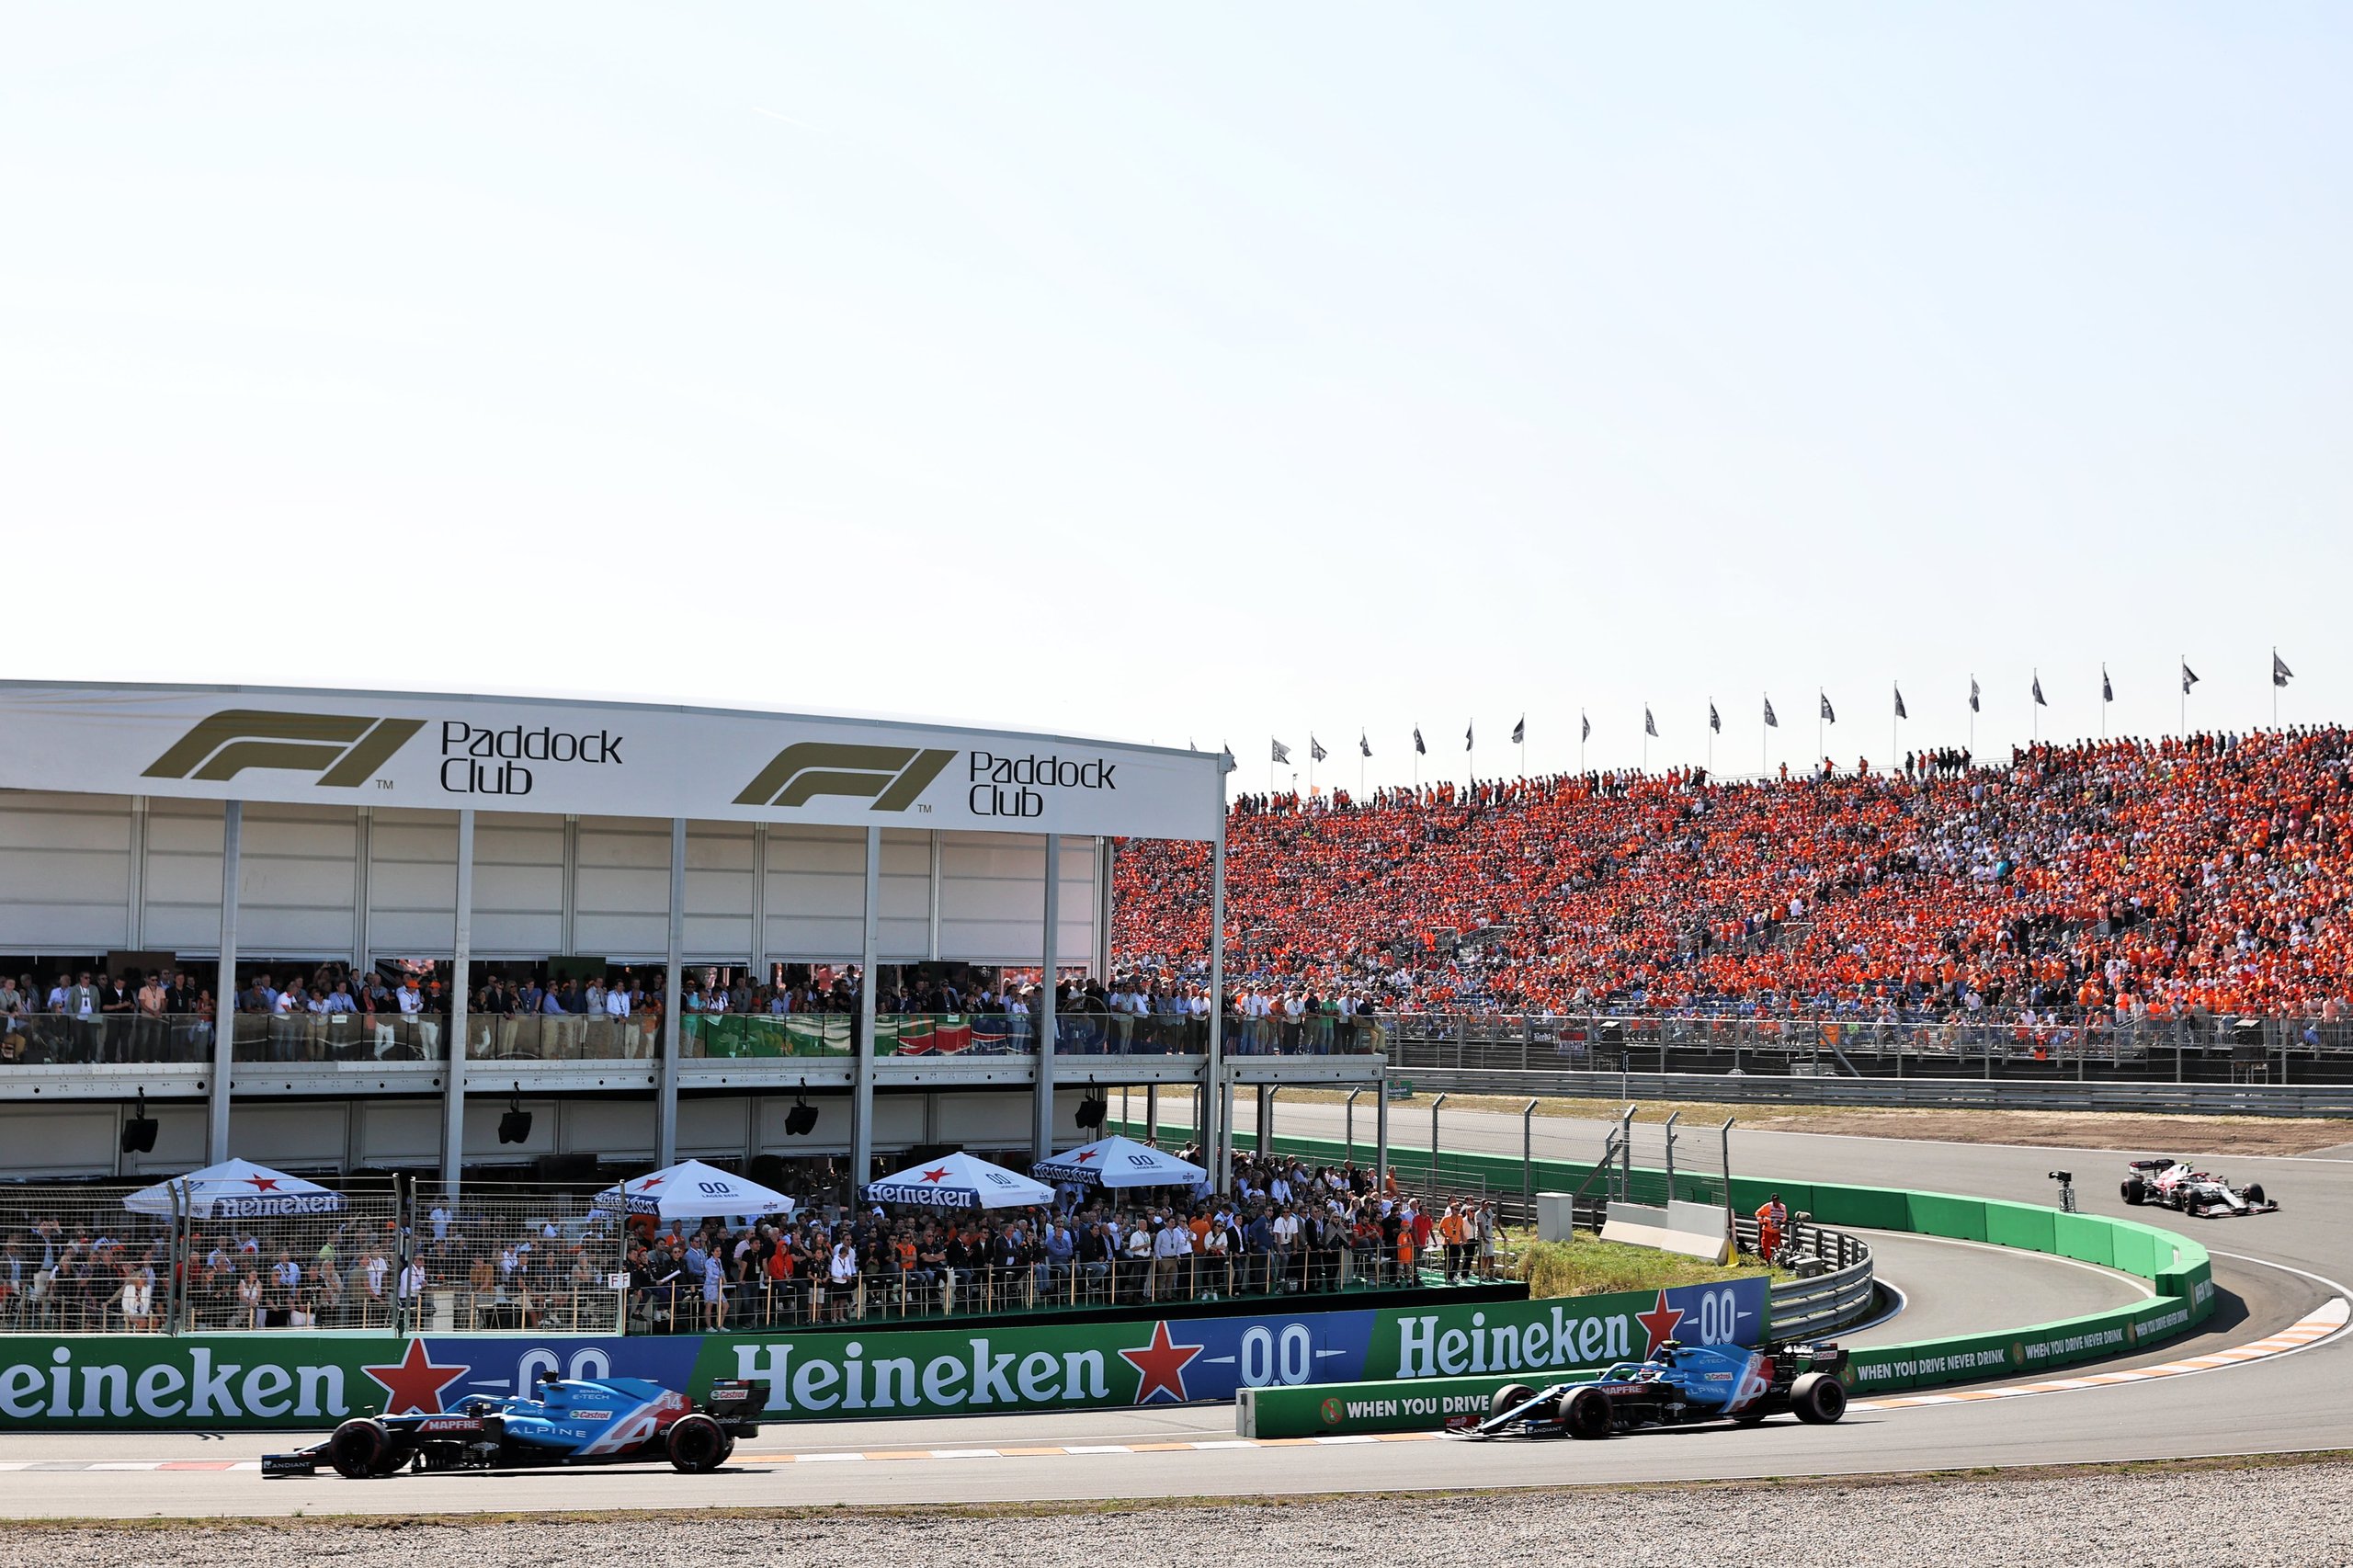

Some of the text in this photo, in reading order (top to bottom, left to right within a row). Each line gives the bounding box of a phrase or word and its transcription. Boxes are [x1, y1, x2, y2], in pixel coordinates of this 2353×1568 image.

[442, 721, 623, 764] Paddock
[440, 757, 533, 795] Club
[970, 751, 1116, 790] Paddock
[376, 778, 393, 790] TM
[917, 803, 932, 813] TM
[969, 784, 1043, 817] Club
[1128, 1155, 1154, 1165] 0.0
[1034, 1163, 1101, 1185] Heineken
[699, 1182, 730, 1194] 0.0
[868, 1185, 972, 1208] Heineken
[222, 1192, 340, 1217] Heineken
[1700, 1289, 1735, 1346] 0.0
[1395, 1306, 1631, 1379] Heineken
[2025, 1328, 2123, 1359] WHEN YOU DRIVE NEVER DRINK
[1240, 1323, 1312, 1388] 0.0
[1858, 1348, 2006, 1381] WHEN YOU DRIVE NEVER DRINK
[733, 1338, 1109, 1411] Heineken
[1602, 1384, 1643, 1394] MAPFRE
[665, 1394, 684, 1410] 14
[1347, 1395, 1490, 1419] WHEN YOU DRIVE
[429, 1420, 480, 1430] MAPFRE
[579, 1411, 609, 1420] Castrol
[508, 1426, 587, 1438] ALPINE
